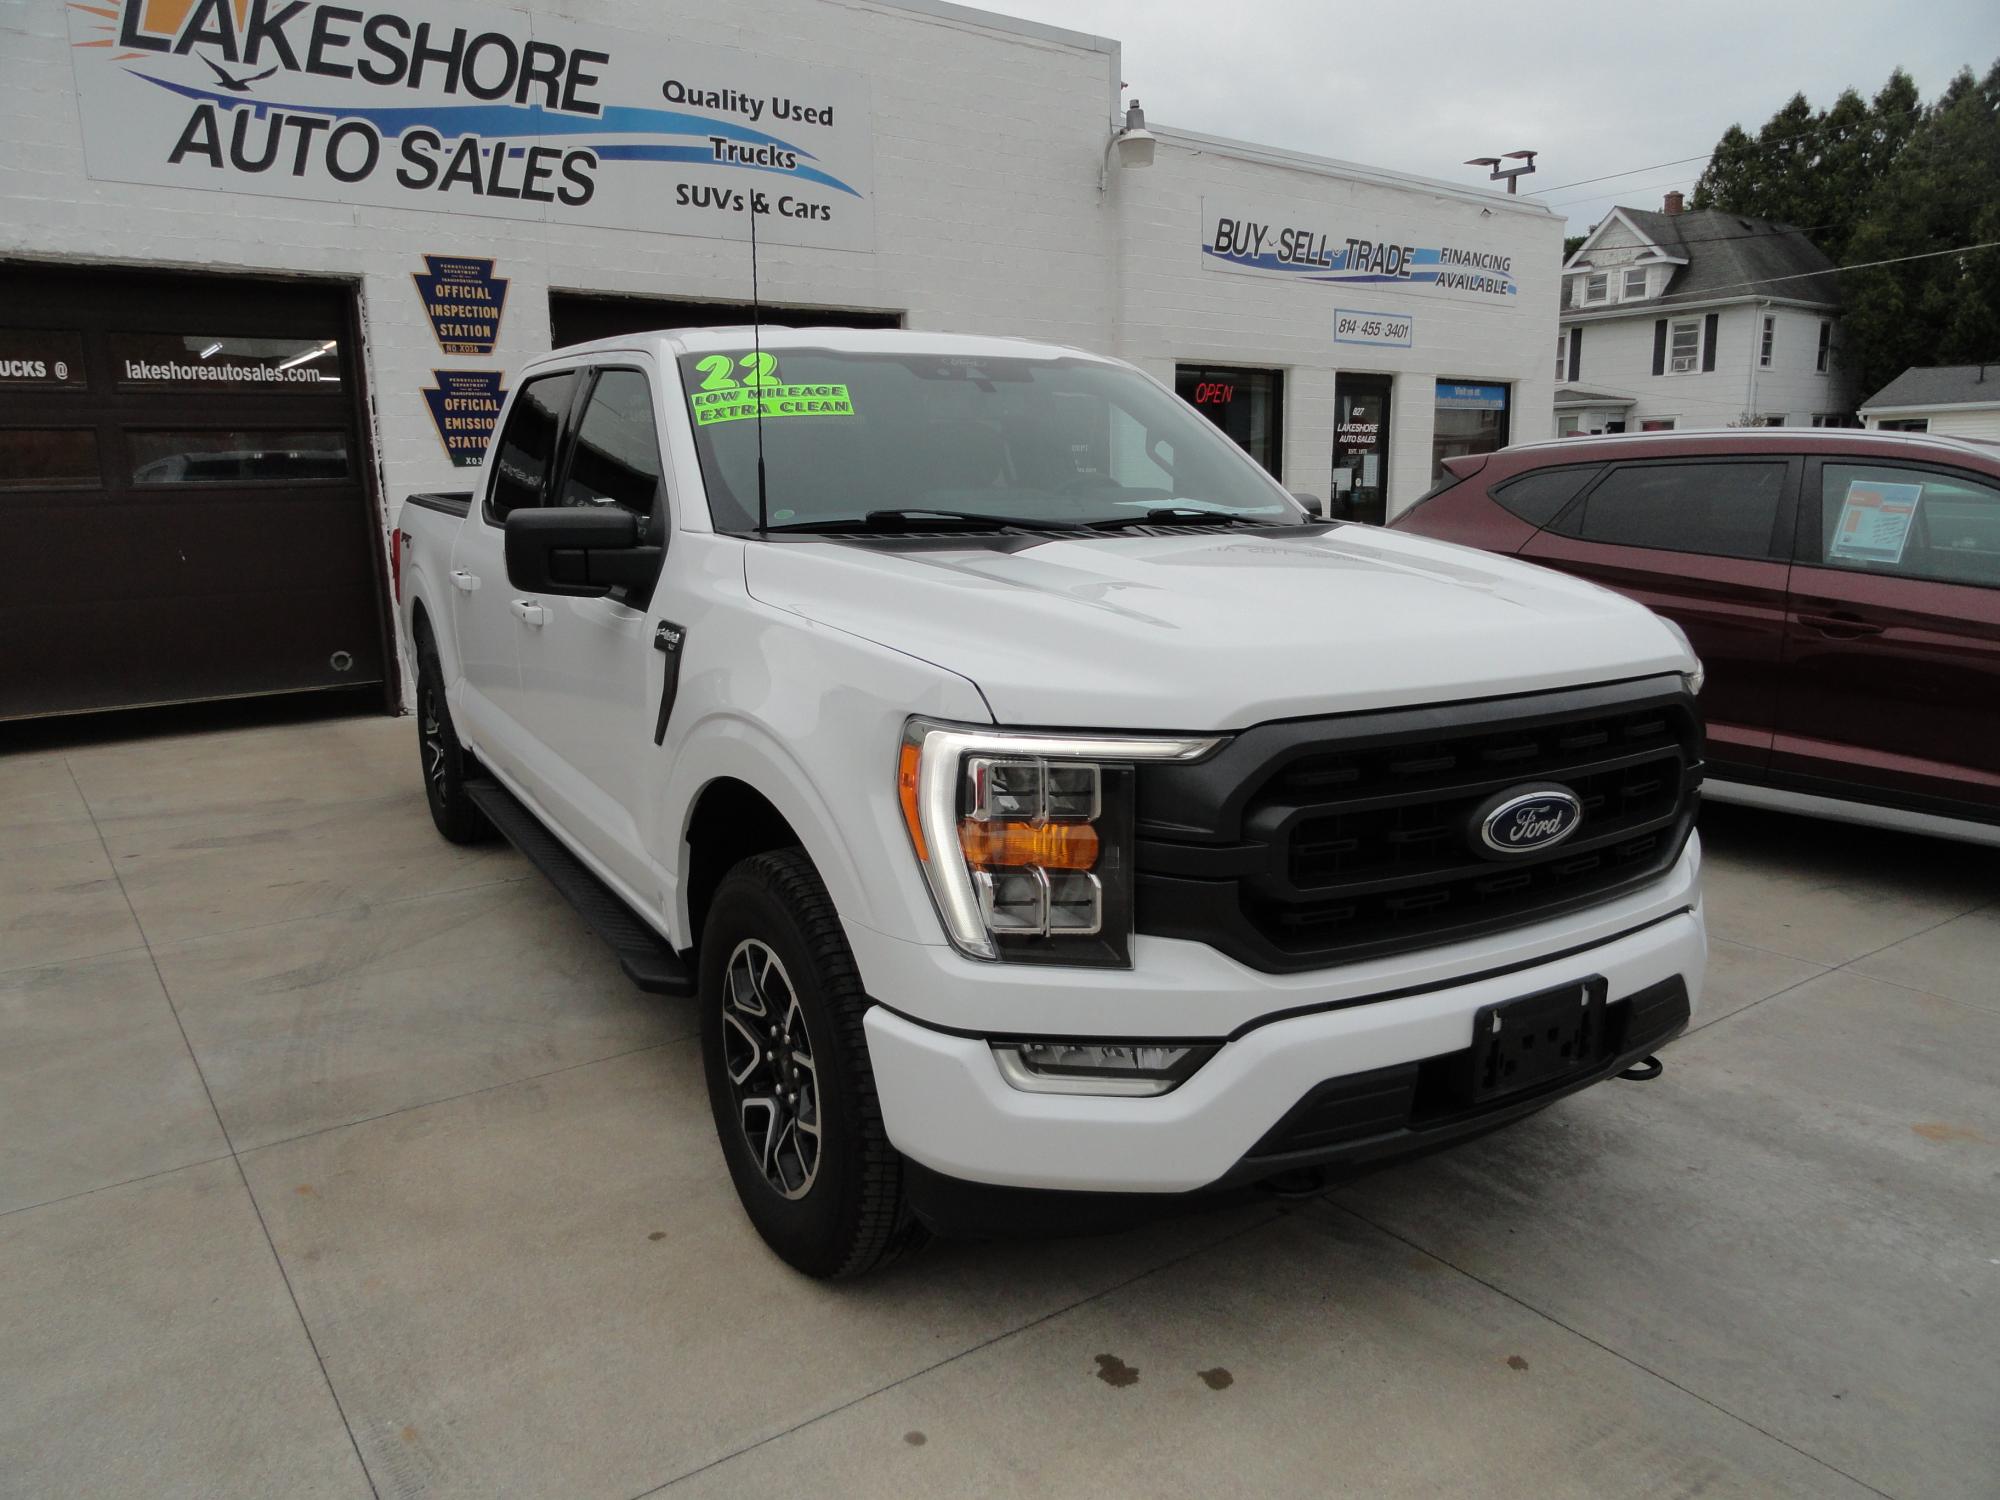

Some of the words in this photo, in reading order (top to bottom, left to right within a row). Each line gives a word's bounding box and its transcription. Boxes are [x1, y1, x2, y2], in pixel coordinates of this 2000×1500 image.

[119, 0, 610, 115] LAKESHORE
[662, 80, 765, 122] Quality
[772, 97, 833, 126] Used
[167, 104, 380, 183] AUTO
[396, 130, 598, 206] SALES
[709, 137, 796, 169] Trucks
[676, 183, 744, 212] SUVs
[752, 193, 770, 214] &
[778, 196, 831, 221] Cars
[1214, 218, 1269, 259] BUY
[1278, 228, 1331, 267] SELL
[1345, 238, 1415, 277] TRADE
[1440, 247, 1511, 271] FINANCING
[435, 284, 492, 300] OFFICIAL
[1435, 272, 1508, 295] AVAILABLE
[430, 304, 498, 319] INSPECTION
[440, 324, 491, 337] STATION
[55, 362, 69, 380] @
[125, 359, 321, 382] lakeshoreautosales.com
[695, 352, 782, 391] 22
[695, 391, 740, 406] LOW
[747, 386, 845, 400] MILEAGE
[1196, 383, 1234, 403] OPEN
[444, 398, 500, 411] OFFICIAL
[701, 404, 772, 421] EXTRA
[780, 401, 849, 414] CLEAN
[1337, 424, 1379, 433] LAKESHORE
[1339, 435, 1357, 443] AUTO
[449, 436, 490, 449] STATIO
[1510, 805, 1563, 842] Ford
